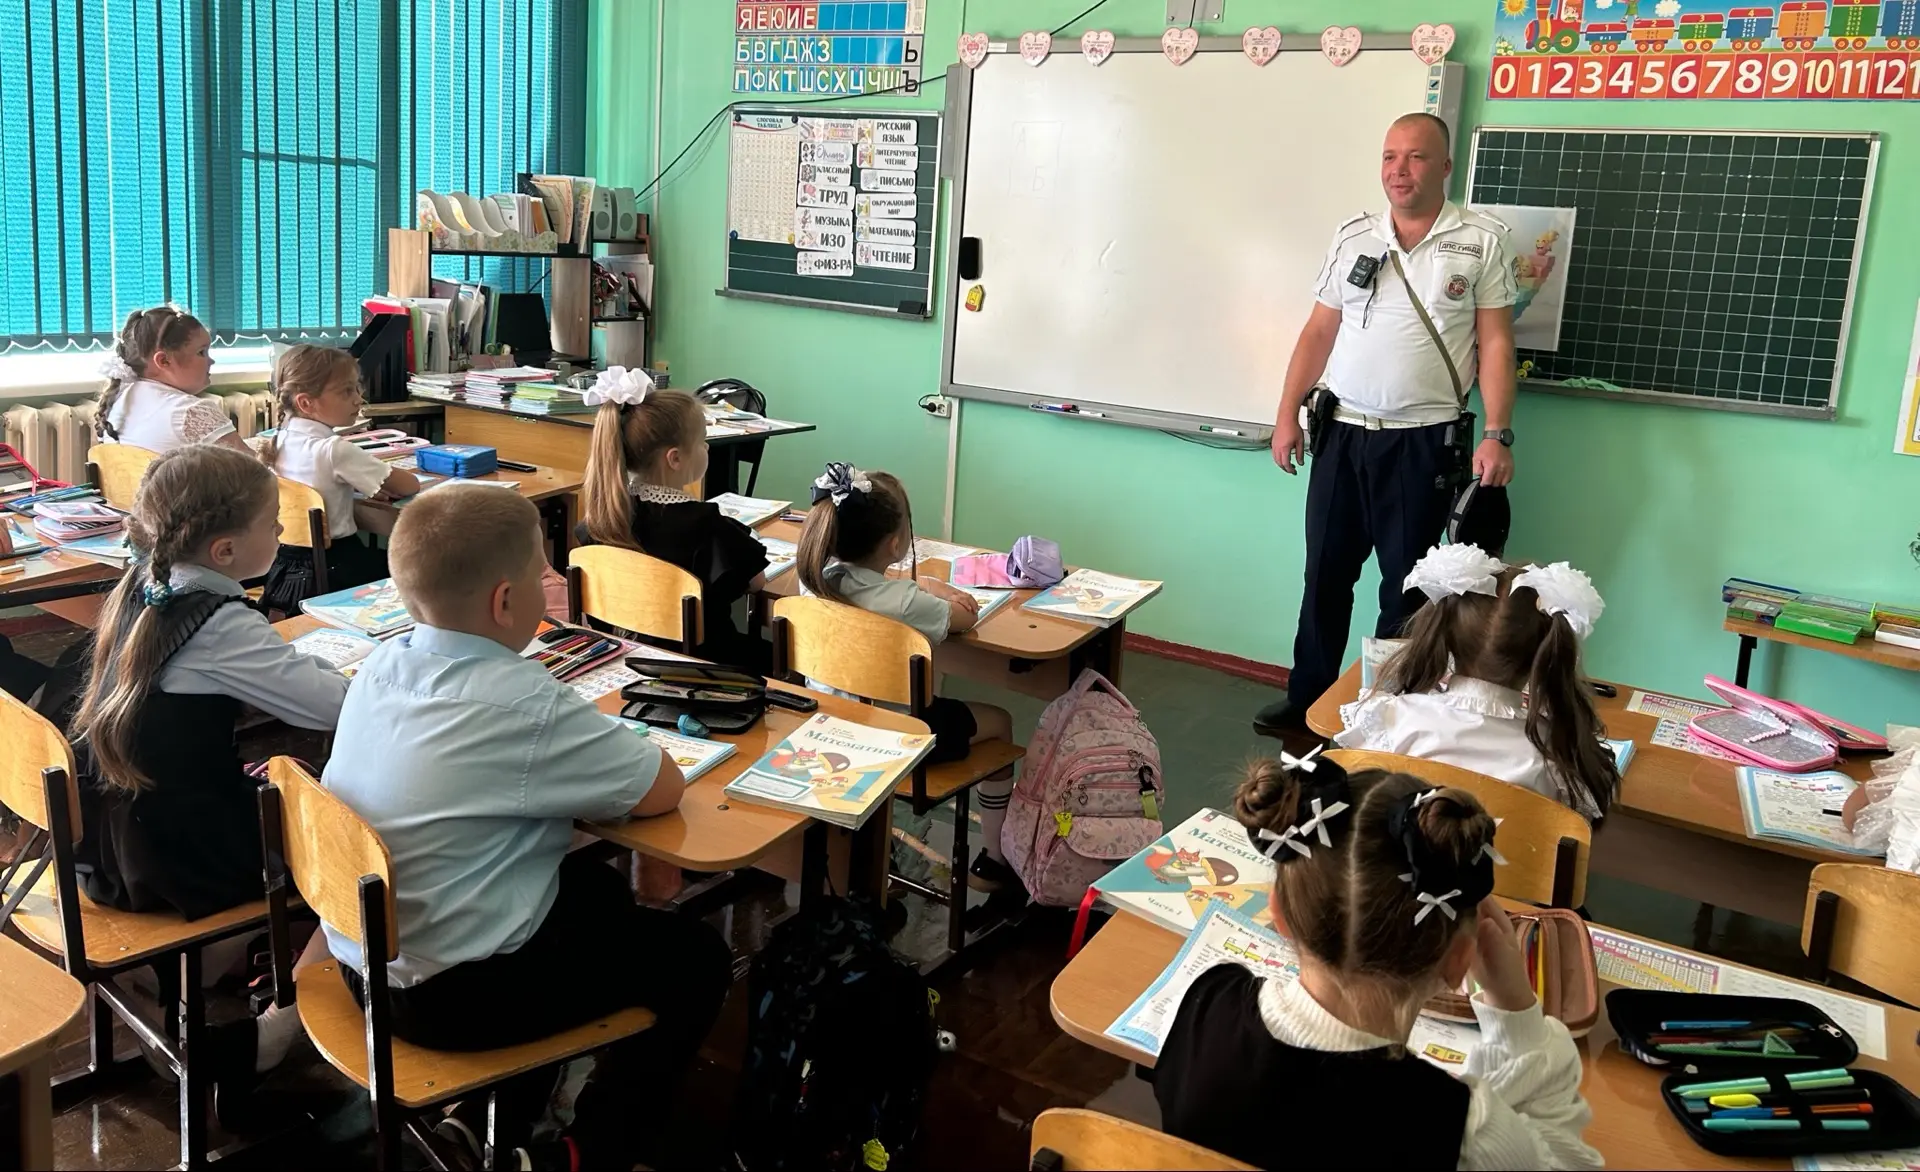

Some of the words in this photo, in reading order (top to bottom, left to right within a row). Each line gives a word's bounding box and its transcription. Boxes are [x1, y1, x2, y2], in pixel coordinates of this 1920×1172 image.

[1494, 63, 1516, 93] 0
[1527, 62, 1542, 93] 1
[1550, 62, 1573, 93] 2
[1579, 61, 1602, 93] 3
[1608, 61, 1633, 93] 4
[1640, 61, 1665, 93] 5
[1671, 60, 1696, 93] 6
[1704, 60, 1731, 93] 7
[1735, 59, 1763, 93] 8
[1771, 59, 1798, 93] 9
[1804, 59, 1834, 93] 10
[1840, 60, 1869, 94] 11
[1874, 59, 1906, 94] 12
[876, 121, 911, 131] РУССКИЙ
[882, 134, 905, 143] ЯЗЫК
[876, 149, 917, 158] ЛИТЕРАТУРНОЕ
[816, 165, 850, 175] КЛАССНЫЙ
[879, 176, 914, 186] ПИСЬМО
[819, 189, 848, 205] ТРУД
[872, 199, 915, 208] ОКРУЖАЮЩИЙ
[815, 216, 850, 226] МУЗЫКА
[869, 226, 915, 238] МАТЕМАТИКА
[820, 234, 845, 248] ИЗО
[1458, 245, 1481, 255] ГИБДД
[872, 250, 913, 264] ЧТЕНИЕ
[814, 259, 852, 271] ФИЗ-РА
[804, 730, 903, 756] Математика
[834, 770, 886, 803] 1
[1188, 827, 1276, 867] Математ
[1148, 897, 1175, 912] Часть
